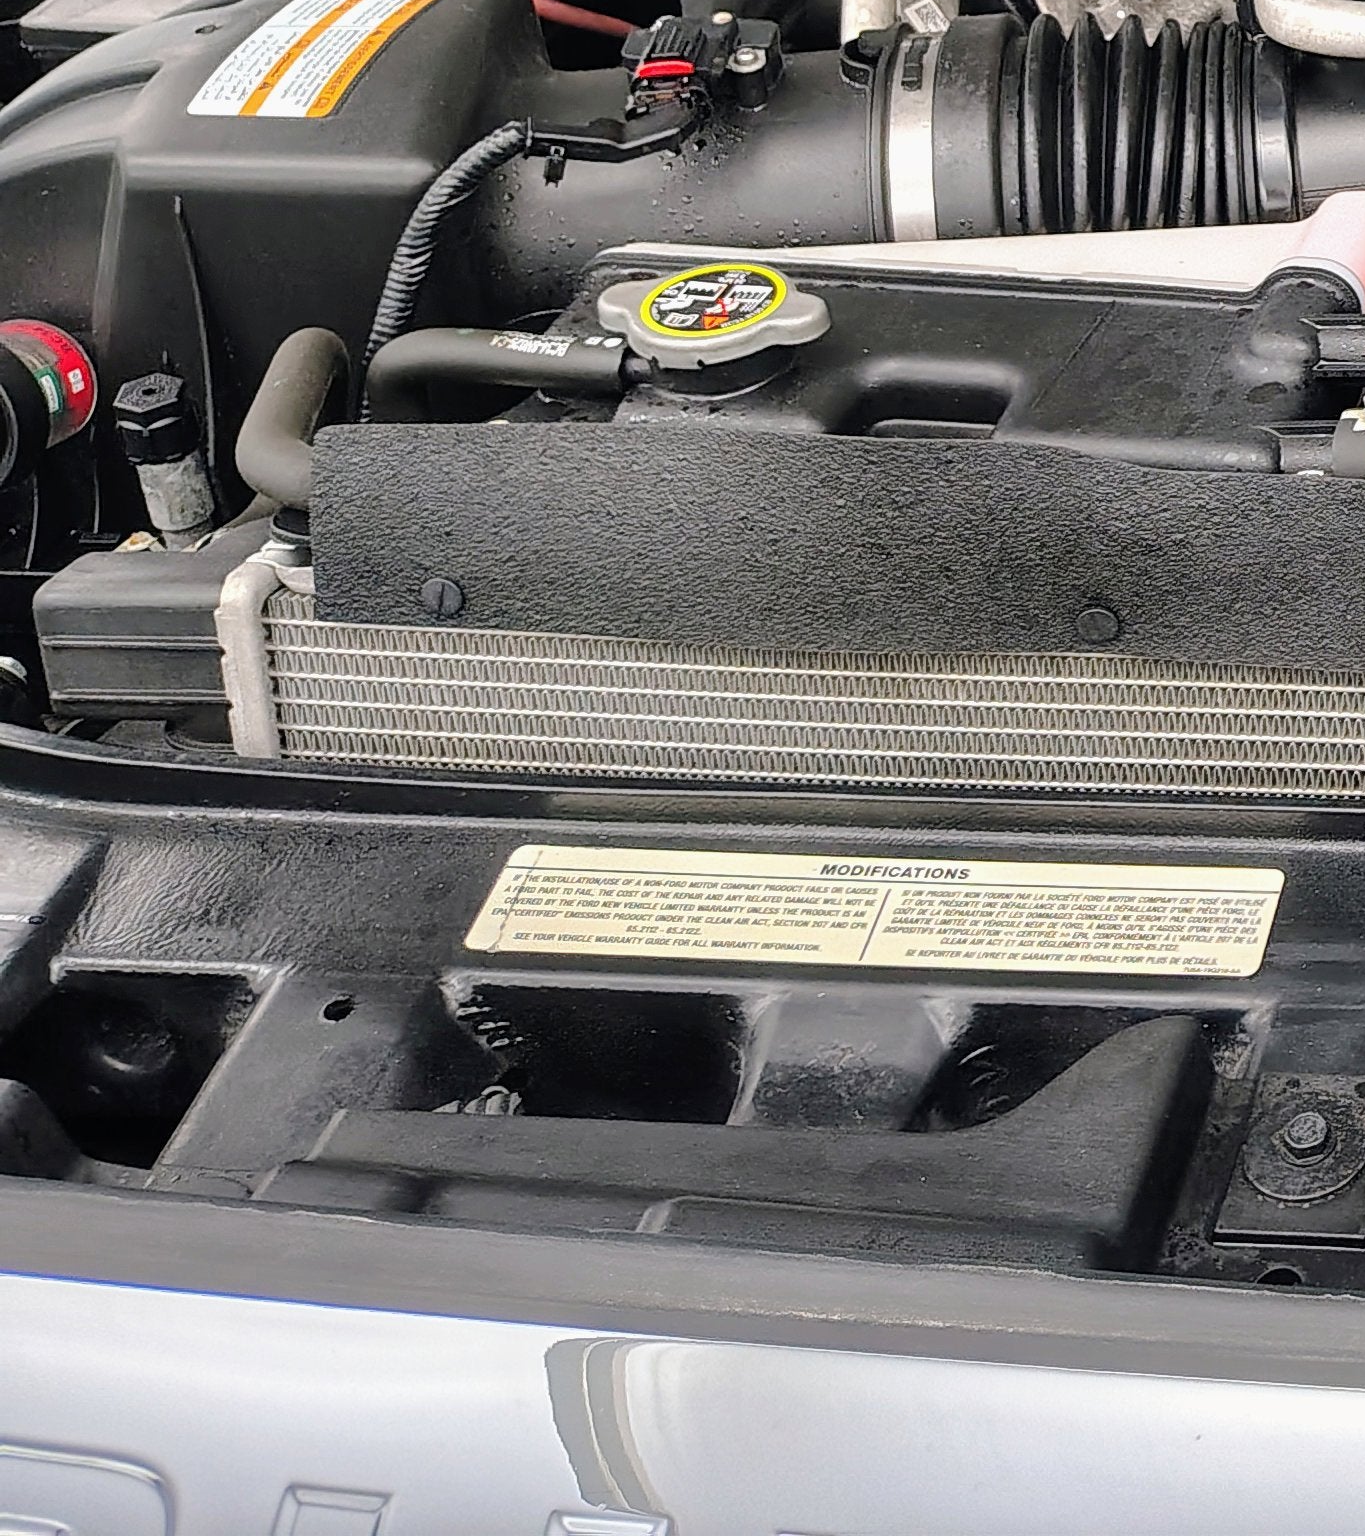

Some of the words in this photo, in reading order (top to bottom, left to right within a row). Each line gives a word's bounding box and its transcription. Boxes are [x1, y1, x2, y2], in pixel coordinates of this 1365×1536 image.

[819, 864, 972, 879] MODIFICATIONS
[523, 874, 541, 883] THE
[688, 881, 719, 889] MOTOR
[720, 882, 762, 891] COMPANY
[763, 884, 804, 892] PRODUCT
[804, 885, 830, 893] FAILS
[844, 887, 878, 895] CAUSES
[512, 885, 537, 894] FORD
[537, 886, 560, 895] PART
[597, 889, 615, 897] THE
[615, 889, 639, 898] COST
[654, 891, 672, 899] THE
[672, 891, 704, 900] REPAIR
[705, 893, 724, 901] AND
[725, 893, 744, 901] ANY
[744, 894, 783, 903] RELATED
[784, 896, 821, 904] DAMAGE
[822, 897, 843, 905] WILL
[503, 896, 544, 906] COVERED
[557, 899, 576, 907] THE
[575, 899, 601, 908] FORD
[600, 900, 622, 908] NEW
[622, 901, 659, 910] VEHICLE
[659, 902, 696, 911] LIMITED
[696, 904, 745, 913] WARRANTY
[746, 906, 781, 914] UNLESS
[782, 907, 799, 915] THE
[800, 908, 840, 916] PRODUCT
[490, 907, 510, 916] EPA
[563, 910, 612, 920] EMISSIONS
[612, 912, 653, 921] PRODUCT
[654, 914, 685, 922] UNDER
[686, 915, 703, 923] THE
[704, 916, 734, 924] CLEAN
[734, 917, 751, 925] AIR
[772, 919, 811, 927] SECTION
[512, 932, 531, 940] SEE
[531, 933, 556, 941] YOUR
[556, 934, 593, 942] VEHICLE
[593, 935, 643, 944] WARRANTY
[643, 937, 670, 945] GUIDE
[691, 939, 707, 947] ALL
[709, 940, 758, 949] WARRANTY
